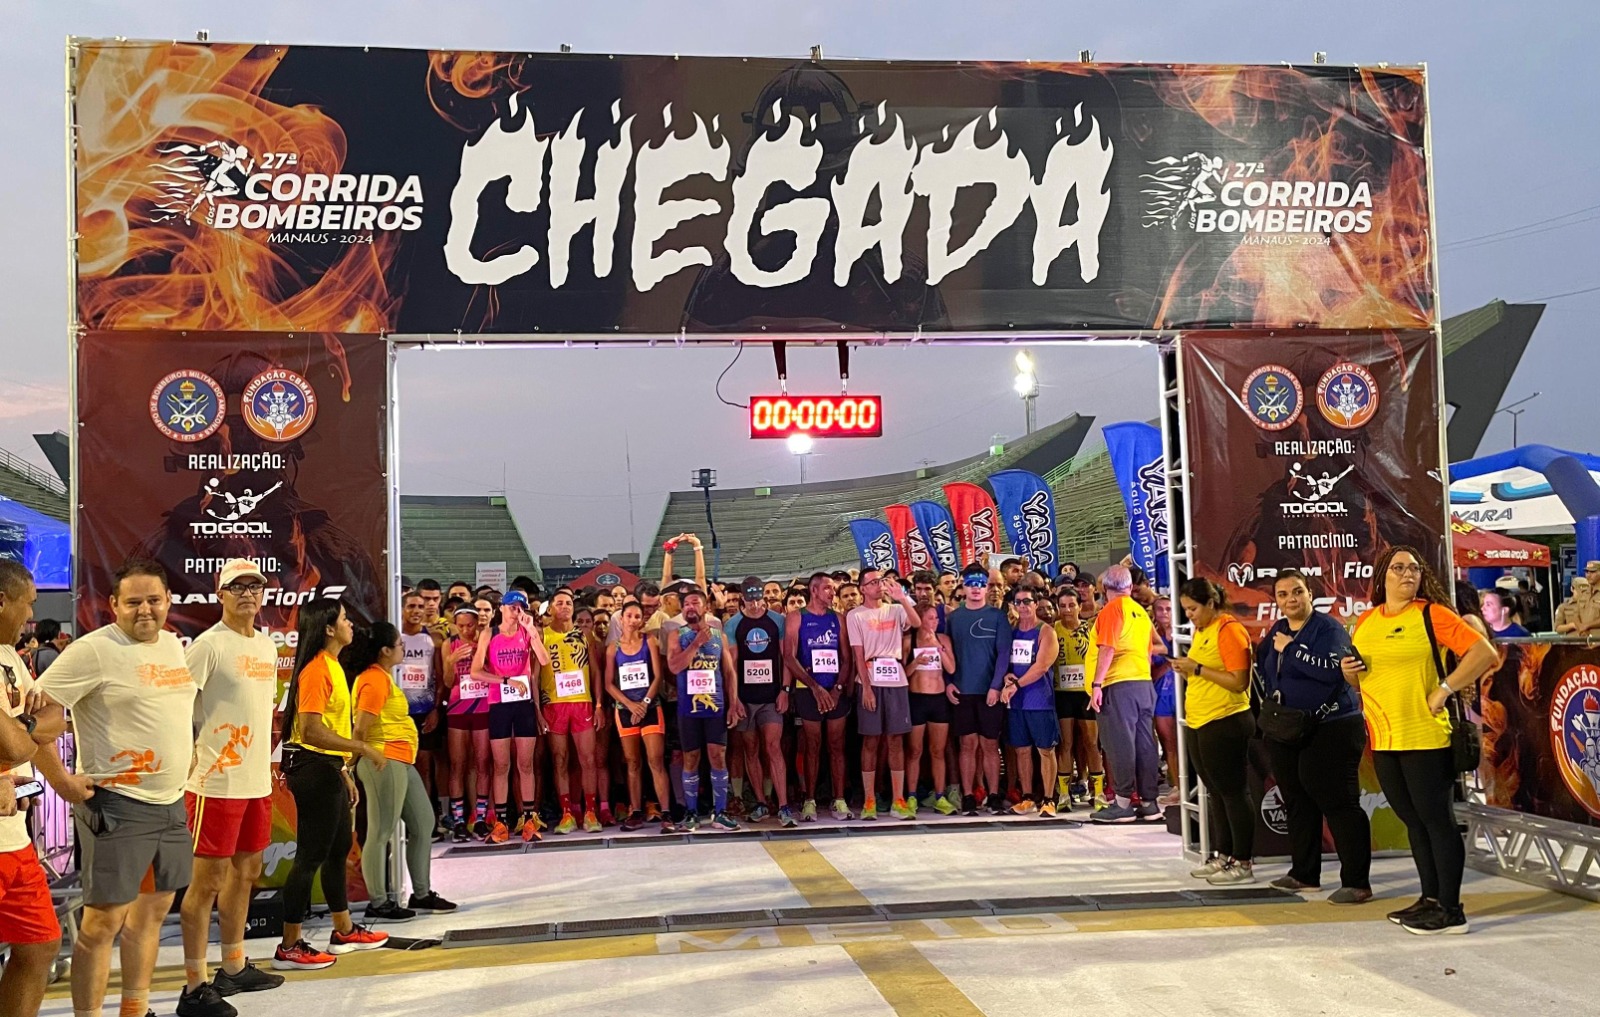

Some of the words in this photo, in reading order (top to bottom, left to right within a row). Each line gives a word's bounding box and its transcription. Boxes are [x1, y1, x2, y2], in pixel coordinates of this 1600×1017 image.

[259, 152, 297, 170] 27ª
[1233, 161, 1265, 178] 27ª
[244, 174, 424, 203] CORRIDA
[443, 91, 1114, 292] CHEGADA
[1221, 181, 1373, 208] CORRIDA
[214, 205, 424, 231] BOMBEIROS
[1195, 209, 1373, 233] BOMBEIROS
[266, 233, 329, 244] MANAUS
[339, 234, 374, 245] 2024
[1242, 235, 1293, 246] MANAUS
[1302, 237, 1331, 246] 2024
[188, 371, 216, 387] MILITAR
[243, 370, 287, 403] FUNDAÇÃO
[289, 374, 315, 403] CBMAM
[1317, 363, 1354, 394] FUNDAÇÃO
[753, 399, 876, 430] 00:00:00
[1275, 438, 1356, 457] REALIZAÇÃO:
[188, 451, 286, 472] REALIZAÇÃO:
[969, 507, 996, 562] YAR
[1021, 491, 1053, 570] YARA
[1136, 519, 1155, 573] mineral
[1278, 531, 1359, 550] PATROCÍNIO:
[869, 533, 895, 571] YAR
[1257, 567, 1322, 578] RM
[1344, 562, 1374, 579] Fio
[262, 588, 317, 606] Fiori
[403, 649, 424, 658] AM
[549, 644, 562, 677] IONS
[814, 658, 837, 666] 2164
[402, 673, 426, 682] 1089
[622, 672, 646, 682] 5612
[746, 668, 770, 676] 5200
[1061, 672, 1084, 682] 5725
[503, 686, 516, 695] 58
[558, 678, 582, 690] 1468
[690, 678, 714, 687] 1057
[1551, 666, 1598, 732] FUNDAÇÃO
